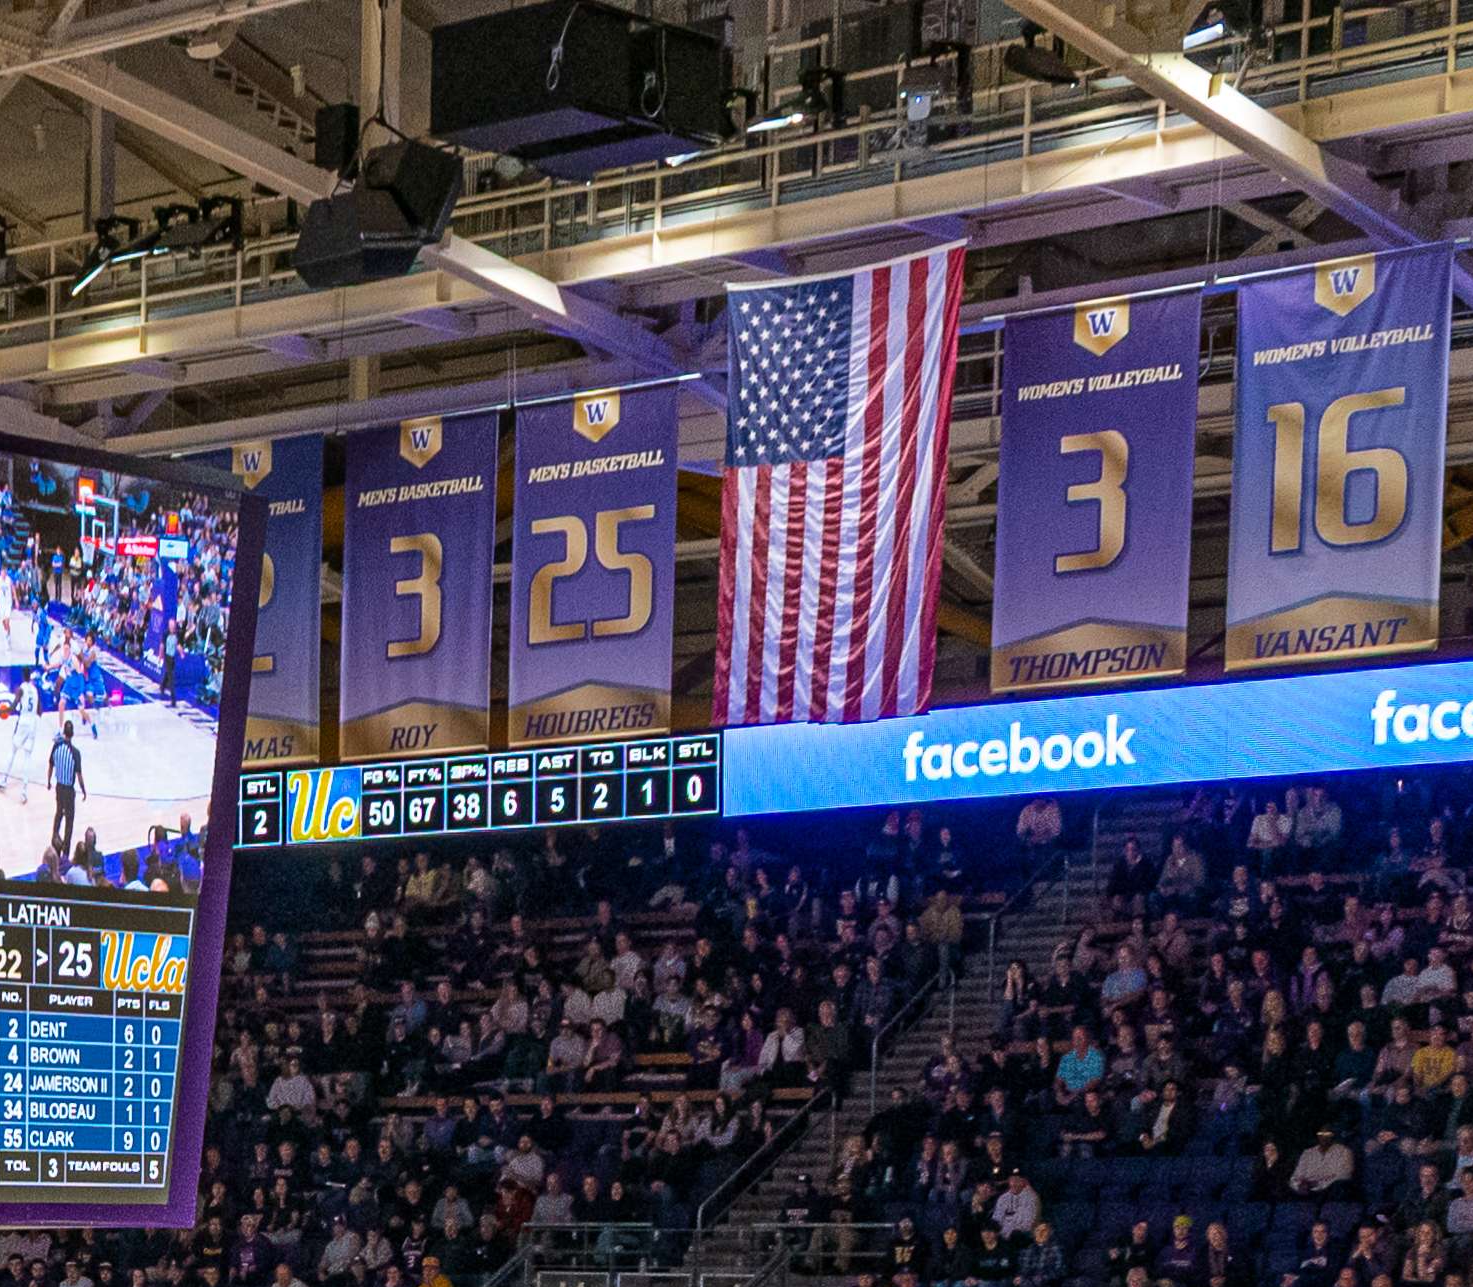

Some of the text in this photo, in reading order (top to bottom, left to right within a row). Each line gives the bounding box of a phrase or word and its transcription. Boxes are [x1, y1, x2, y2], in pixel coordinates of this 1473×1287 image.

[1331, 268, 1359, 294] W
[1088, 311, 1116, 336] W
[1253, 323, 1433, 365] WOMEN'S VOLLEYBALL
[1018, 365, 1182, 401] WOMEN'S VOLLEYBALL
[585, 401, 608, 424] W
[528, 451, 664, 483] MEN'S BASKETBALL
[1268, 387, 1408, 554] 16
[358, 476, 483, 507] MEN'S BASKETBALL
[1056, 430, 1128, 573] 3
[528, 505, 655, 644] 25
[388, 532, 443, 657] 3
[1255, 618, 1408, 658] VANSANT
[1010, 642, 1167, 682] THOMPSON
[526, 703, 654, 738] HOUBREGS
[390, 724, 437, 750] ROY
[902, 714, 1136, 782] facebook
[493, 742, 713, 773] REB AST BLK STL
[369, 791, 480, 826] 50 67 38
[9, 905, 70, 926] LATHAN
[59, 942, 92, 977] 25
[31, 1021, 67, 1039] DENT
[31, 1048, 80, 1065] BROWN
[4, 1073, 23, 1092] 24
[30, 1075, 99, 1093] JAMERSON
[4, 1100, 96, 1120] 34 BILODEAU
[4, 1128, 74, 1147] 55 CLARK
